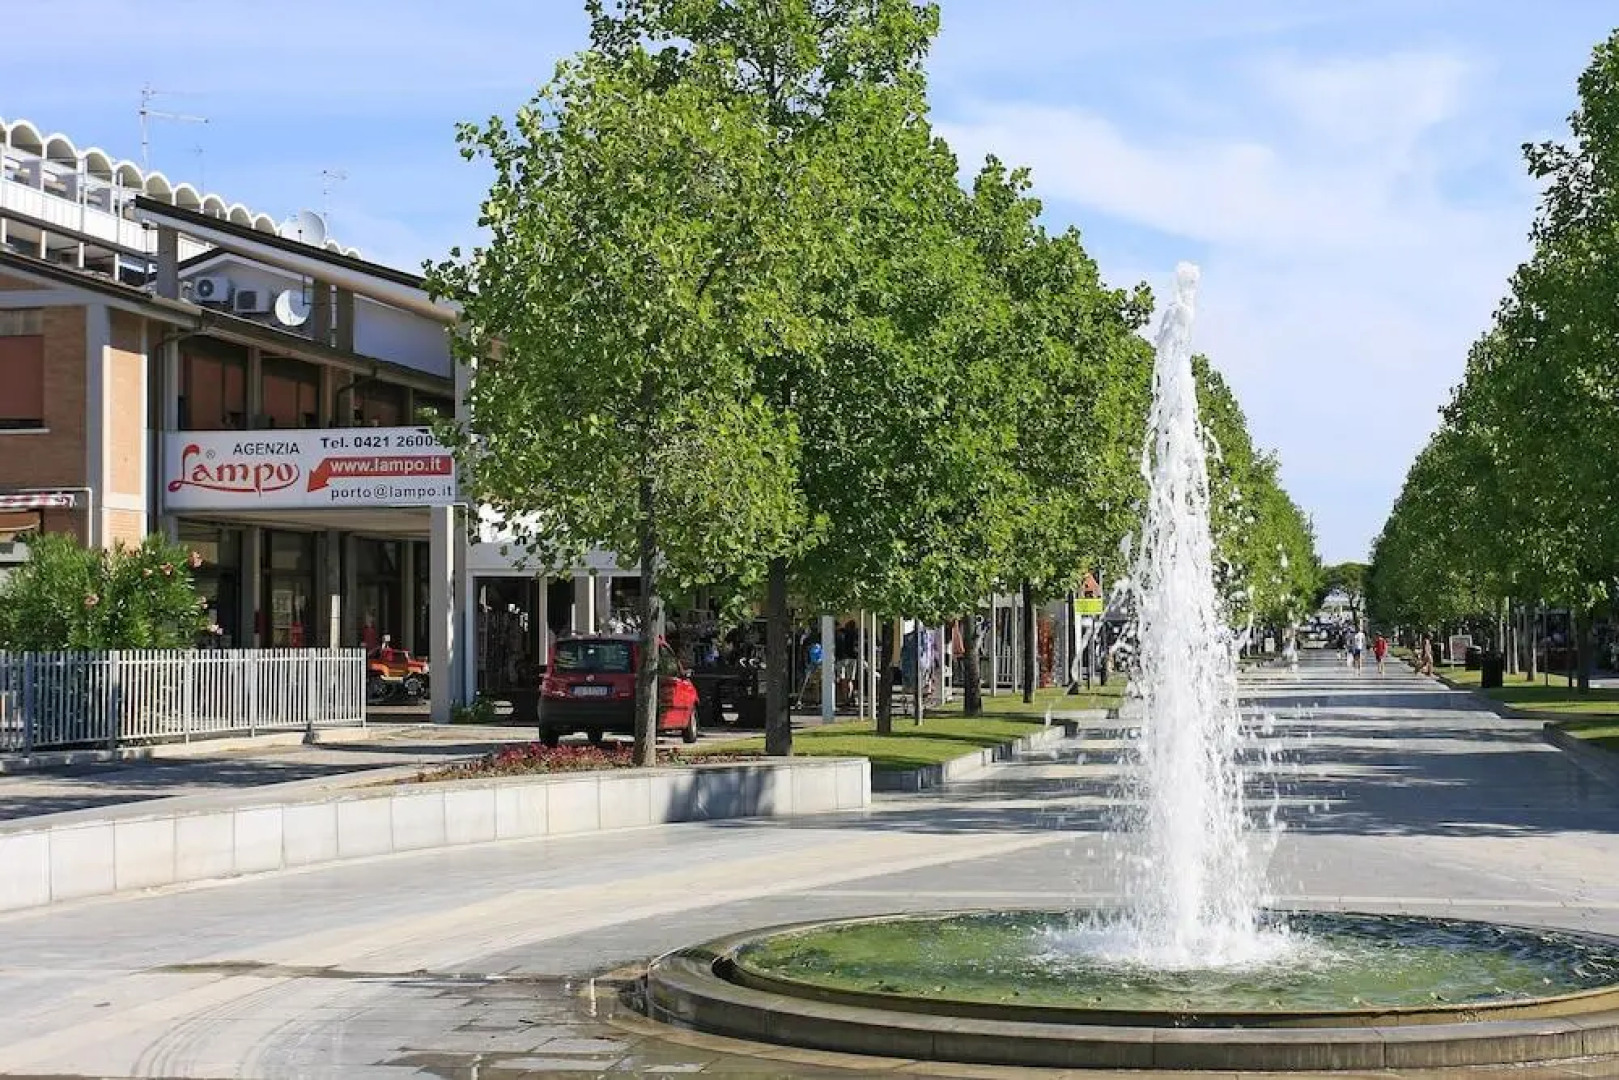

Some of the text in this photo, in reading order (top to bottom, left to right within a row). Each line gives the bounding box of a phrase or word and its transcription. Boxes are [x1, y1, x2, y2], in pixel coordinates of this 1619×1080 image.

[233, 442, 300, 456] AGENZIA
[320, 437, 349, 449] Tel.
[354, 436, 390, 448] 0421
[168, 444, 300, 498] Lampo
[330, 456, 442, 474] www.lampo.it
[331, 484, 452, 501] porto@lampo.it
